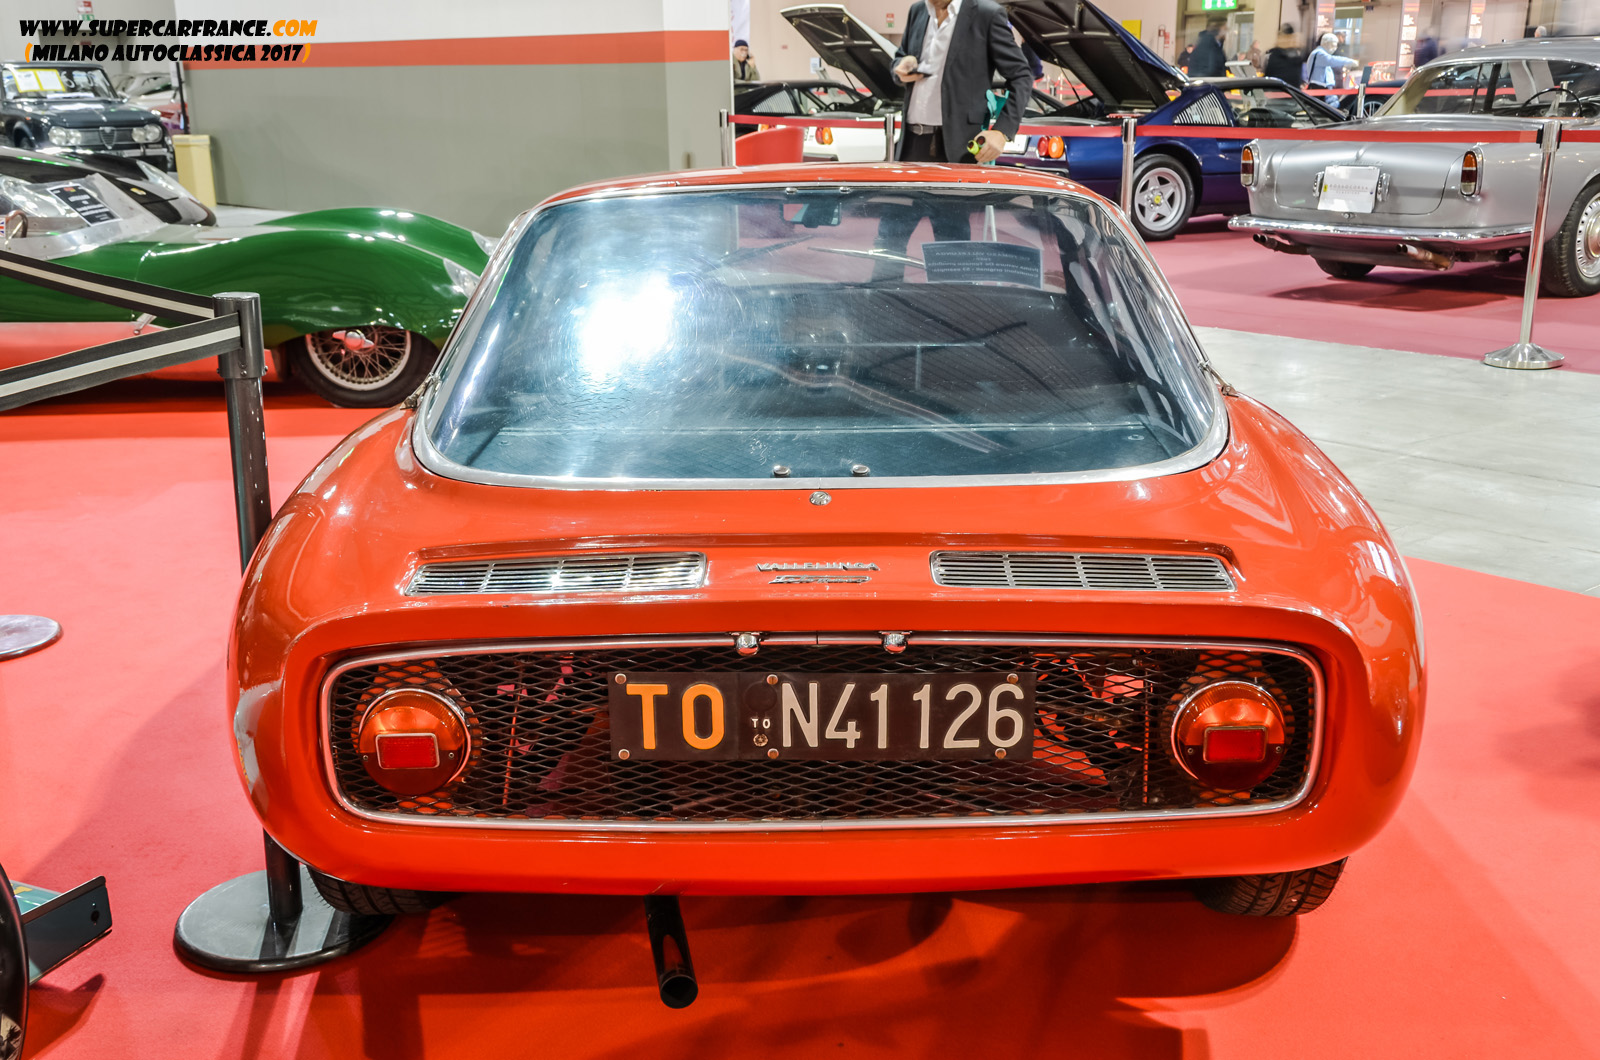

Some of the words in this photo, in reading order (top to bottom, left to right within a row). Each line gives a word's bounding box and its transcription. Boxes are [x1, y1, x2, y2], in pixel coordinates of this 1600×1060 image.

[756, 562, 880, 571] VALLELUNGA
[626, 683, 725, 750] TO
[751, 718, 771, 729] TO
